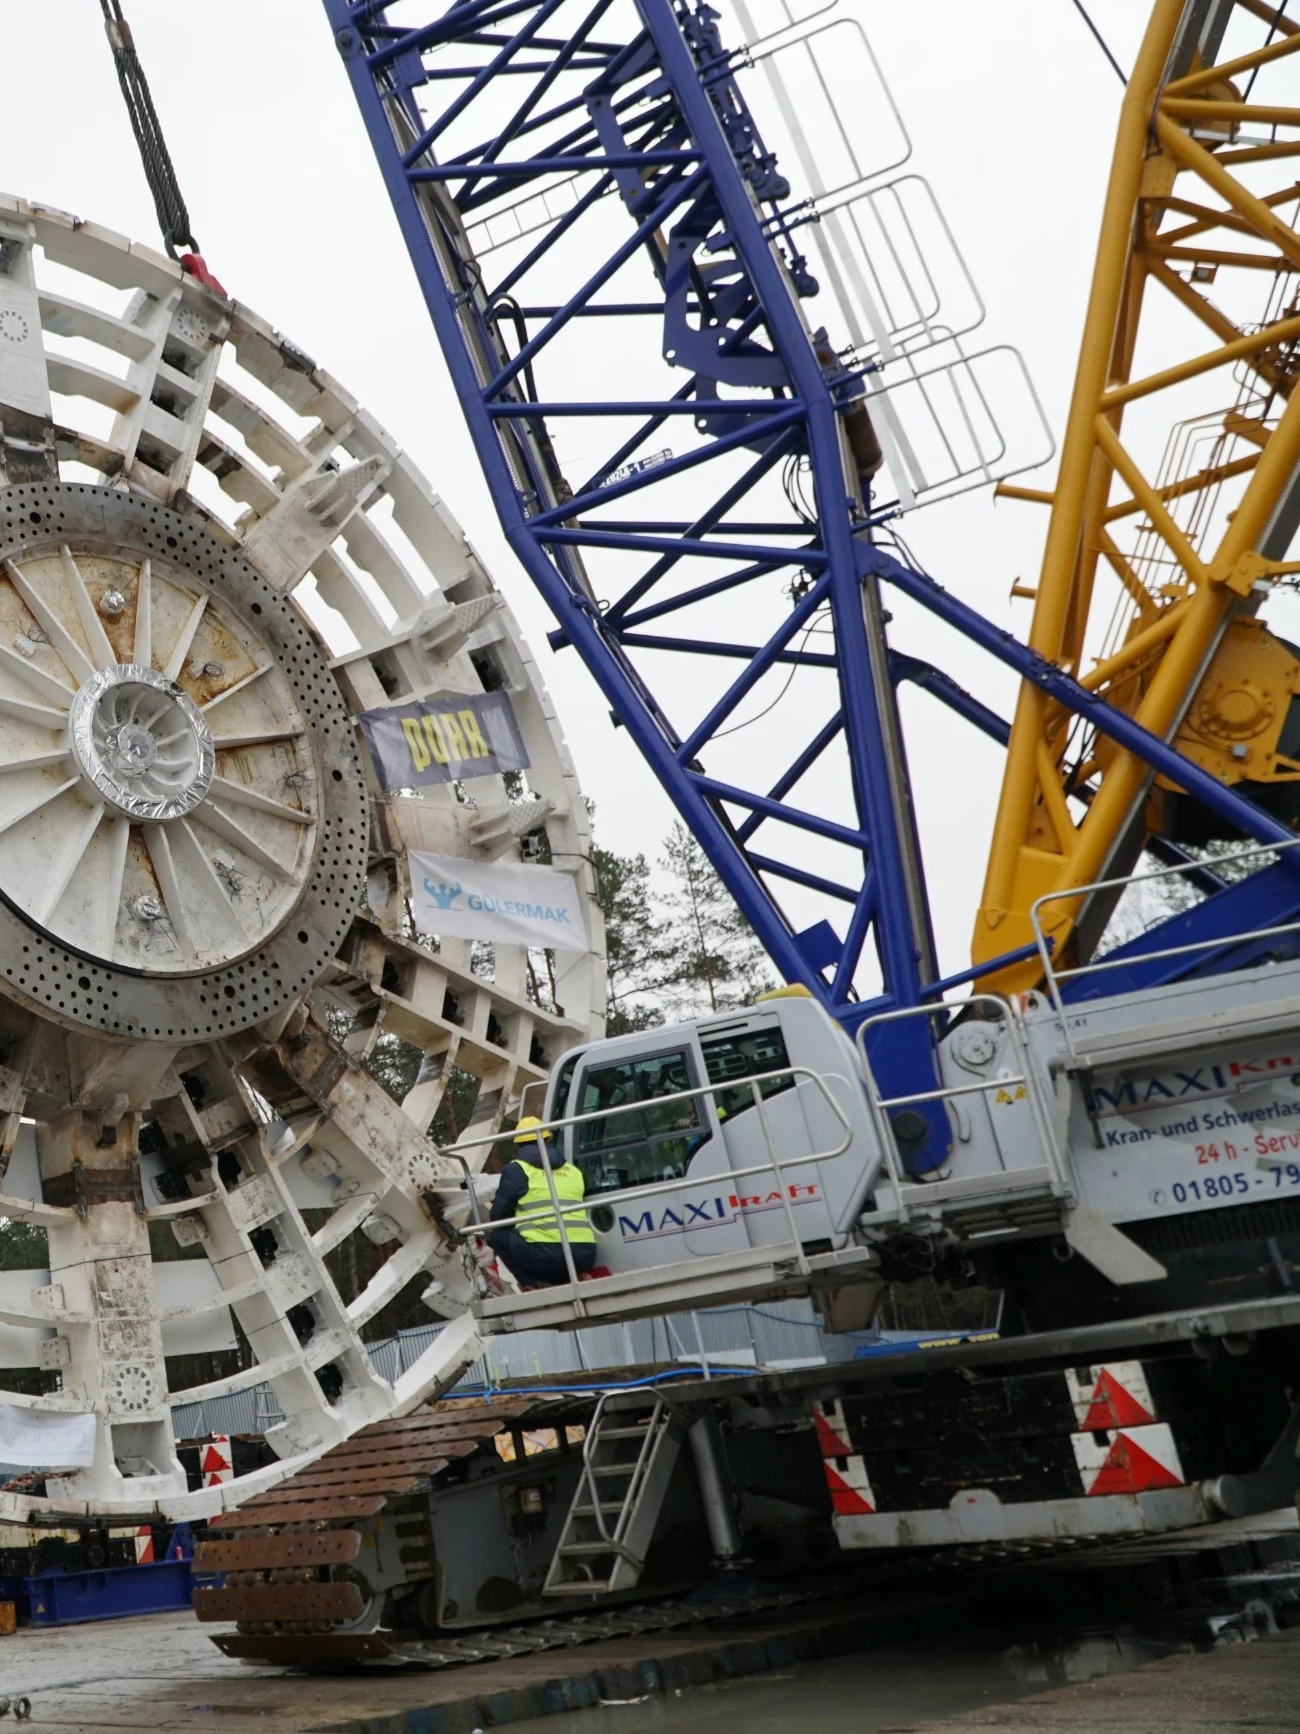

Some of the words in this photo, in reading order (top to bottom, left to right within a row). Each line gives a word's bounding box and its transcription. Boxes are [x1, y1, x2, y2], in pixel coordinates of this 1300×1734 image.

[467, 894, 571, 924] GÜLERMAK
[1106, 1128, 1157, 1147] Kran-
[1162, 1117, 1199, 1138] und
[1194, 1145, 1220, 1165] 24
[1224, 1140, 1238, 1160] h
[1172, 1172, 1249, 1203] 01805
